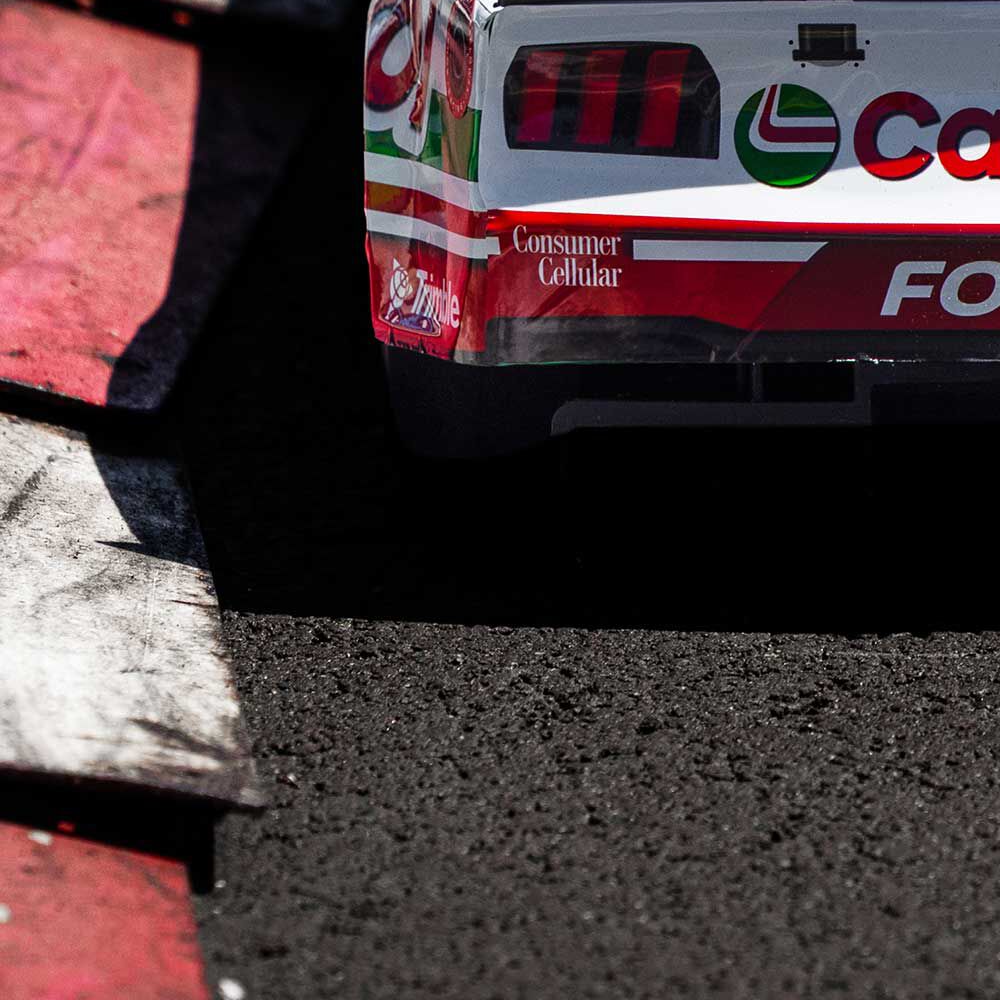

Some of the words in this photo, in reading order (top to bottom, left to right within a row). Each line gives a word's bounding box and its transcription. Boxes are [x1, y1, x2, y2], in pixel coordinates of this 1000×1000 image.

[512, 225, 622, 256] Consumer
[538, 258, 622, 288] Cellular
[411, 268, 460, 328] Trimble
